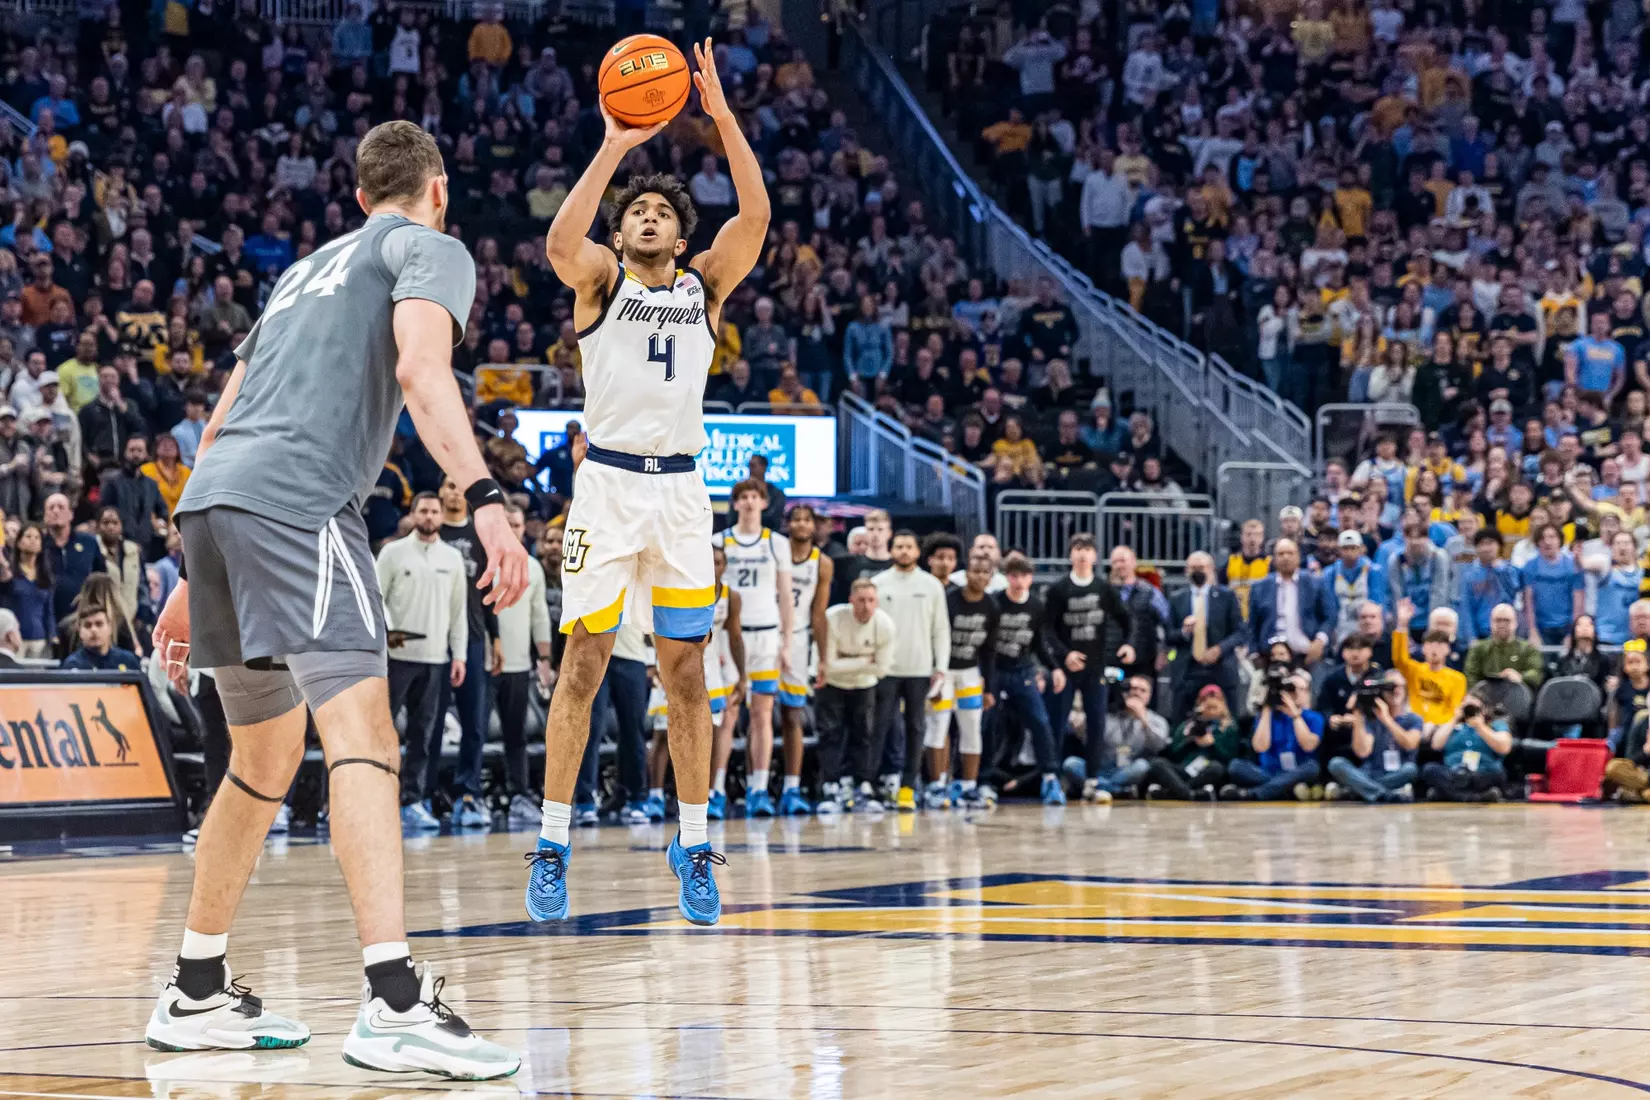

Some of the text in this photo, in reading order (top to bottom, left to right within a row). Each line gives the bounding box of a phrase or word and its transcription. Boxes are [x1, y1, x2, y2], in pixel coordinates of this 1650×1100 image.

[619, 52, 668, 76] ELITE
[262, 240, 360, 325] 24
[616, 298, 704, 329] Marquette
[647, 333, 676, 382] 4
[644, 457, 661, 472] AL
[563, 529, 590, 572] MU
[738, 568, 758, 588] 21
